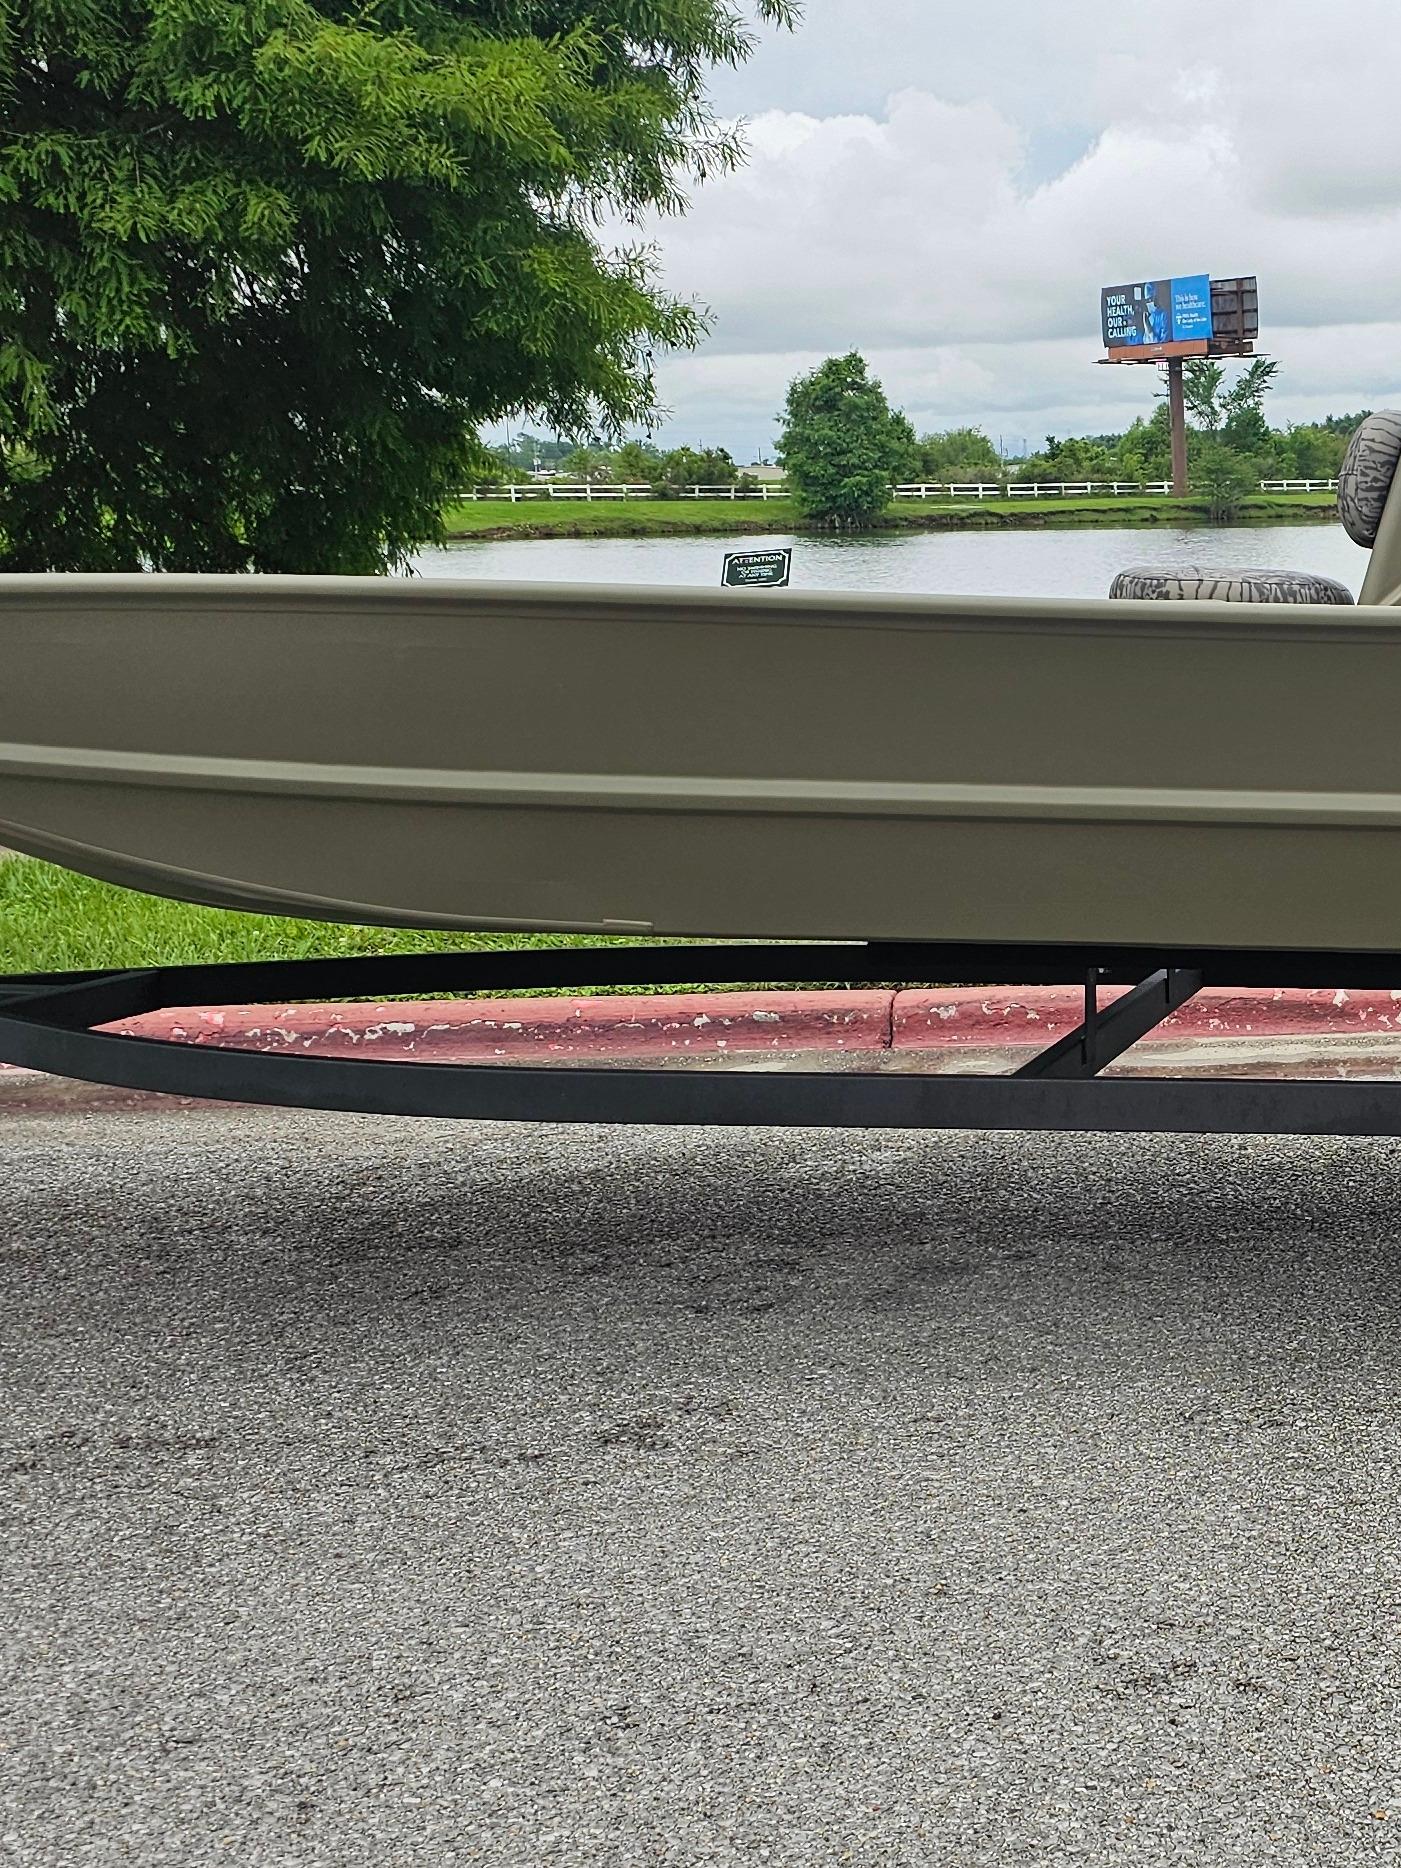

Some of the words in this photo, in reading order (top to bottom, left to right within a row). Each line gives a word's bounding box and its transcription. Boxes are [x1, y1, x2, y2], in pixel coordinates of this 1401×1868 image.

[1107, 294, 1126, 306] YOUR
[1107, 305, 1134, 317] HEALTH,
[1108, 317, 1123, 327] OUR
[1108, 326, 1137, 339] CALLING
[732, 555, 782, 564] ATTENTION
